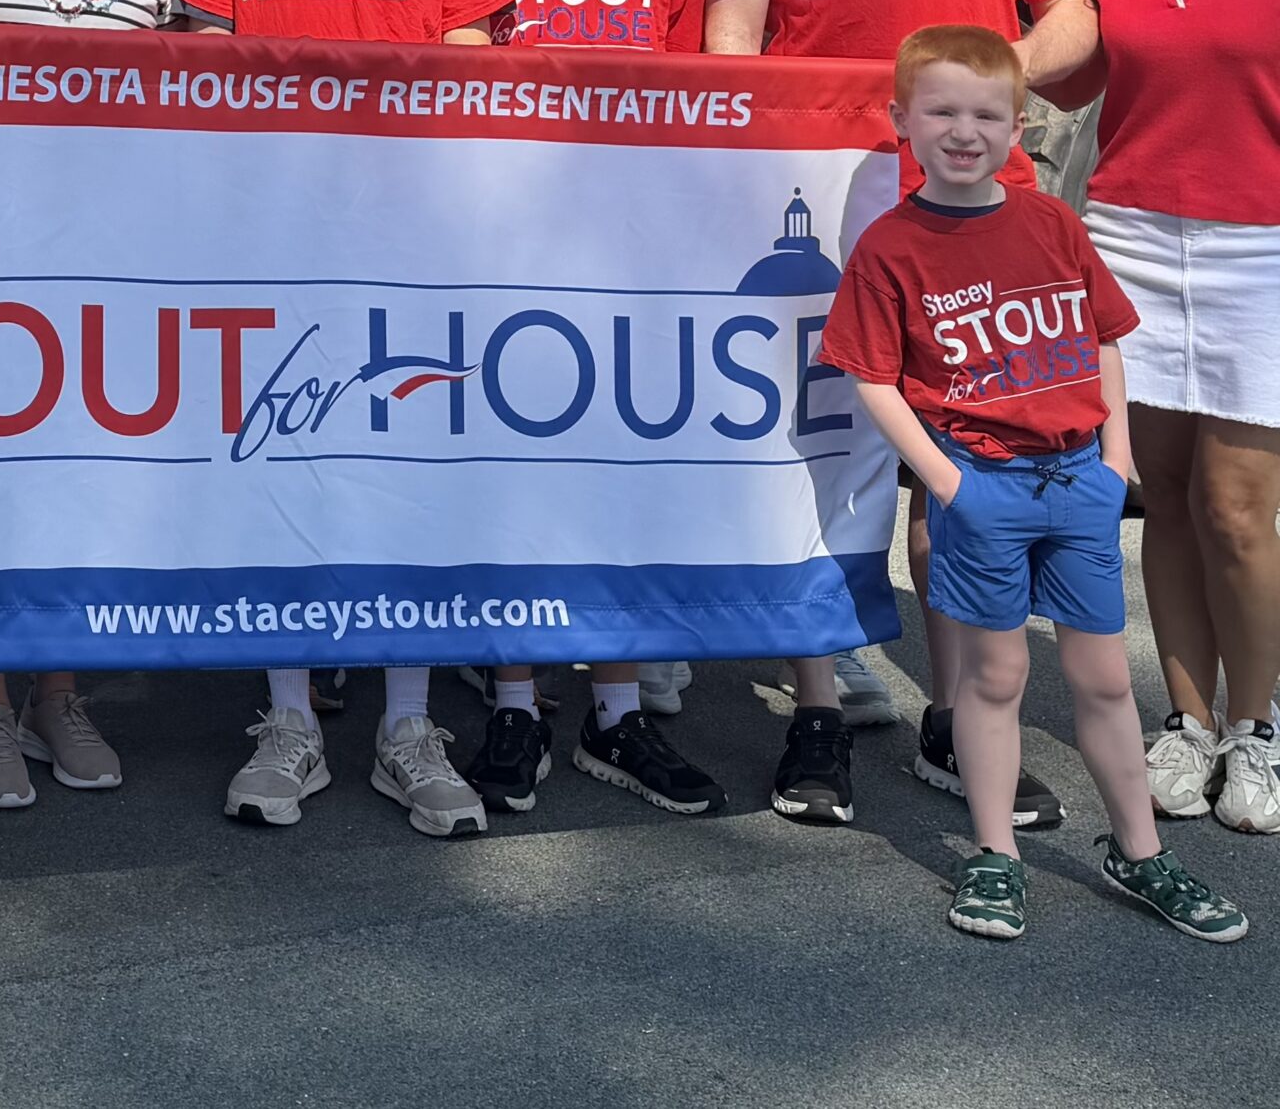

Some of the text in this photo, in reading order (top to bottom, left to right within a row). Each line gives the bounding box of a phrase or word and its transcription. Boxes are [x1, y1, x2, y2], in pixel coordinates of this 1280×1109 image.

[518, 7, 652, 42] HOUSE
[159, 70, 300, 110] HOUSE
[310, 75, 369, 111] OF
[379, 79, 753, 128] REPRESENTATIVES
[922, 281, 993, 317] Stacey
[934, 289, 1087, 365] STOUT
[230, 323, 354, 463] for
[367, 307, 852, 441] HOUSE
[967, 336, 1099, 395] HOUSE
[86, 593, 570, 641] www.staceystout.com
